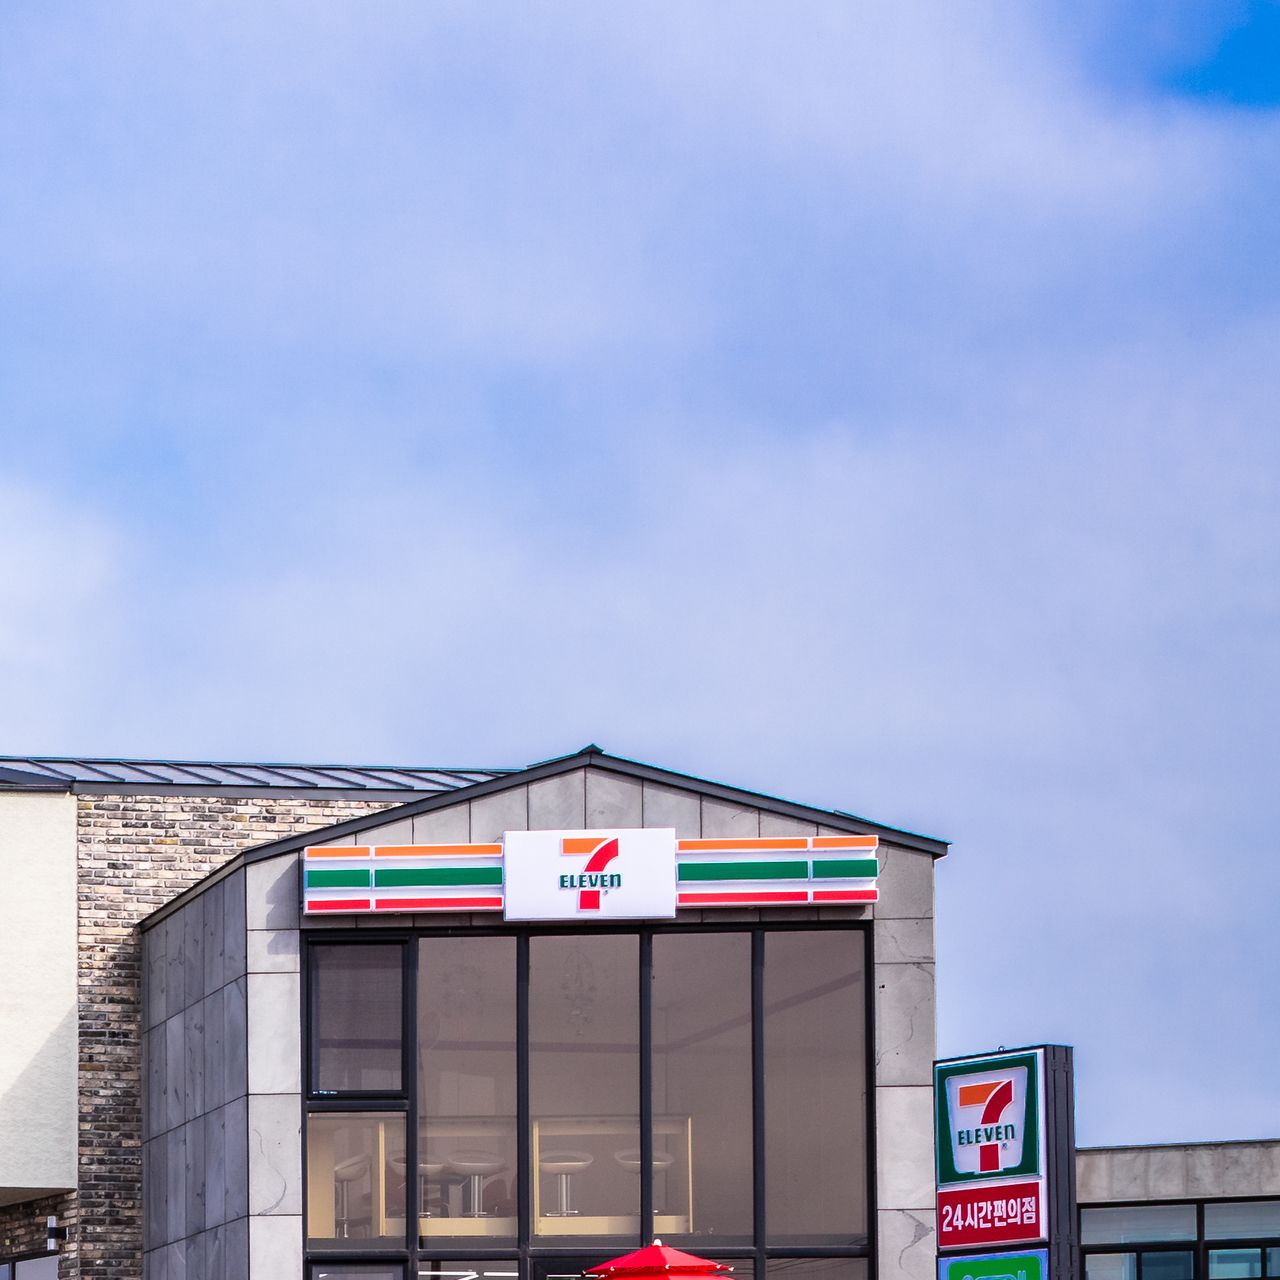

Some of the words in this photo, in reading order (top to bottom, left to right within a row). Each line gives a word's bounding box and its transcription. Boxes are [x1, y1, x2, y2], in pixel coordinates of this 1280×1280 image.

[561, 837, 619, 911] 7
[958, 1078, 1014, 1173] 7
[941, 1196, 1037, 1233] 24시간편의점
